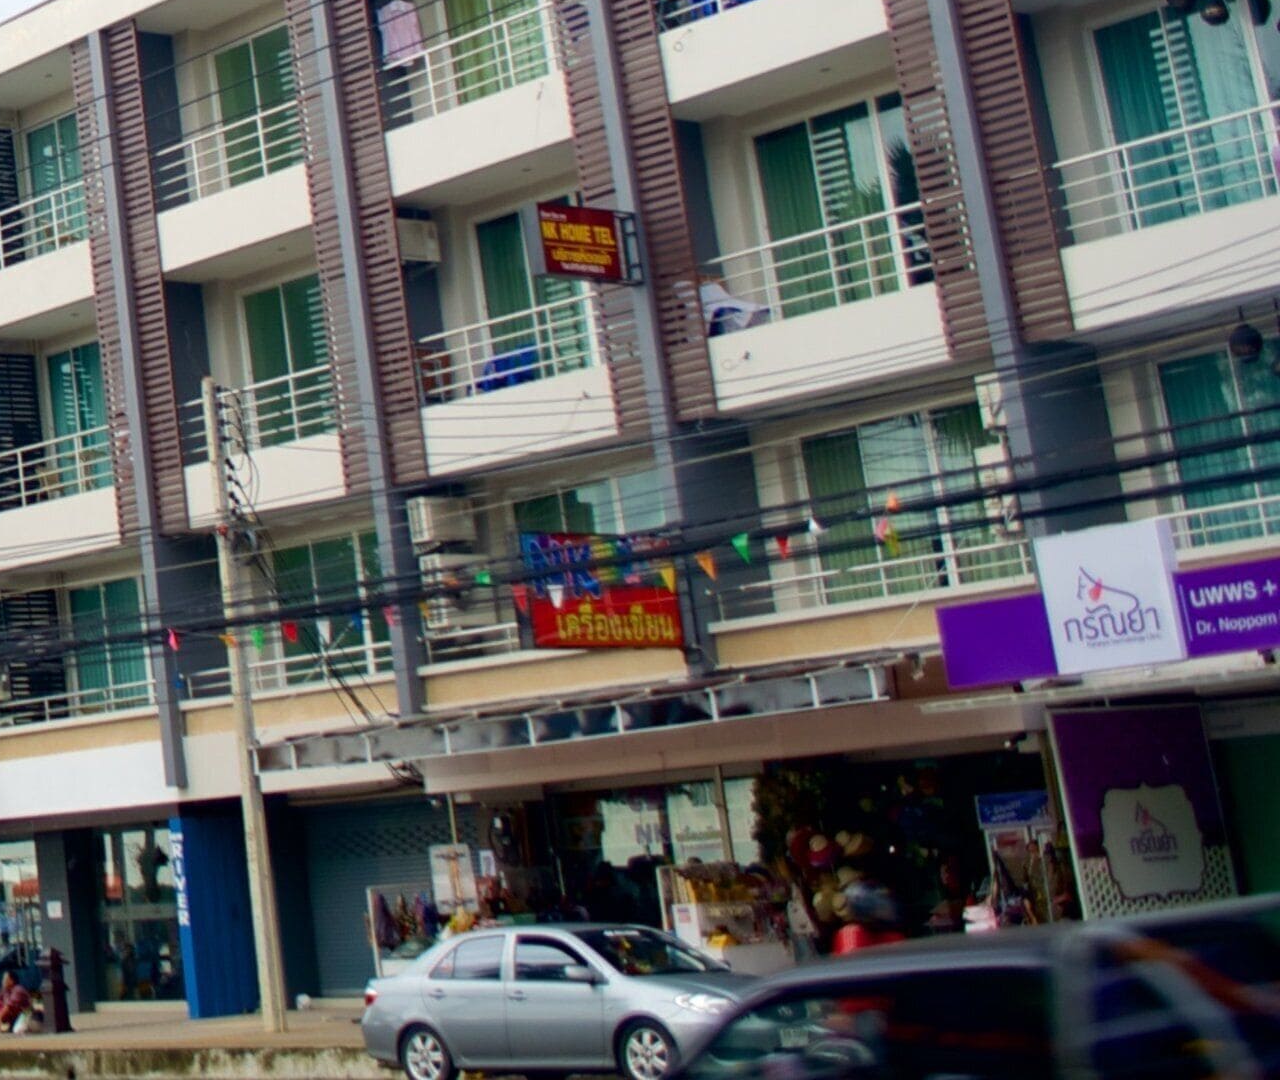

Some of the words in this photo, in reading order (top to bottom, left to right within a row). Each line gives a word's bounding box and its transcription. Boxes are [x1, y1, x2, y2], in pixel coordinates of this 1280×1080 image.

[559, 223, 592, 244] HOME
[593, 227, 616, 246] TEL
[1190, 580, 1258, 608] นพพร
[556, 594, 676, 642] เครื่องเขียน
[1063, 602, 1161, 642] กรัณยา
[1196, 620, 1216, 635] Dr.
[1218, 613, 1276, 635] Nopporn
